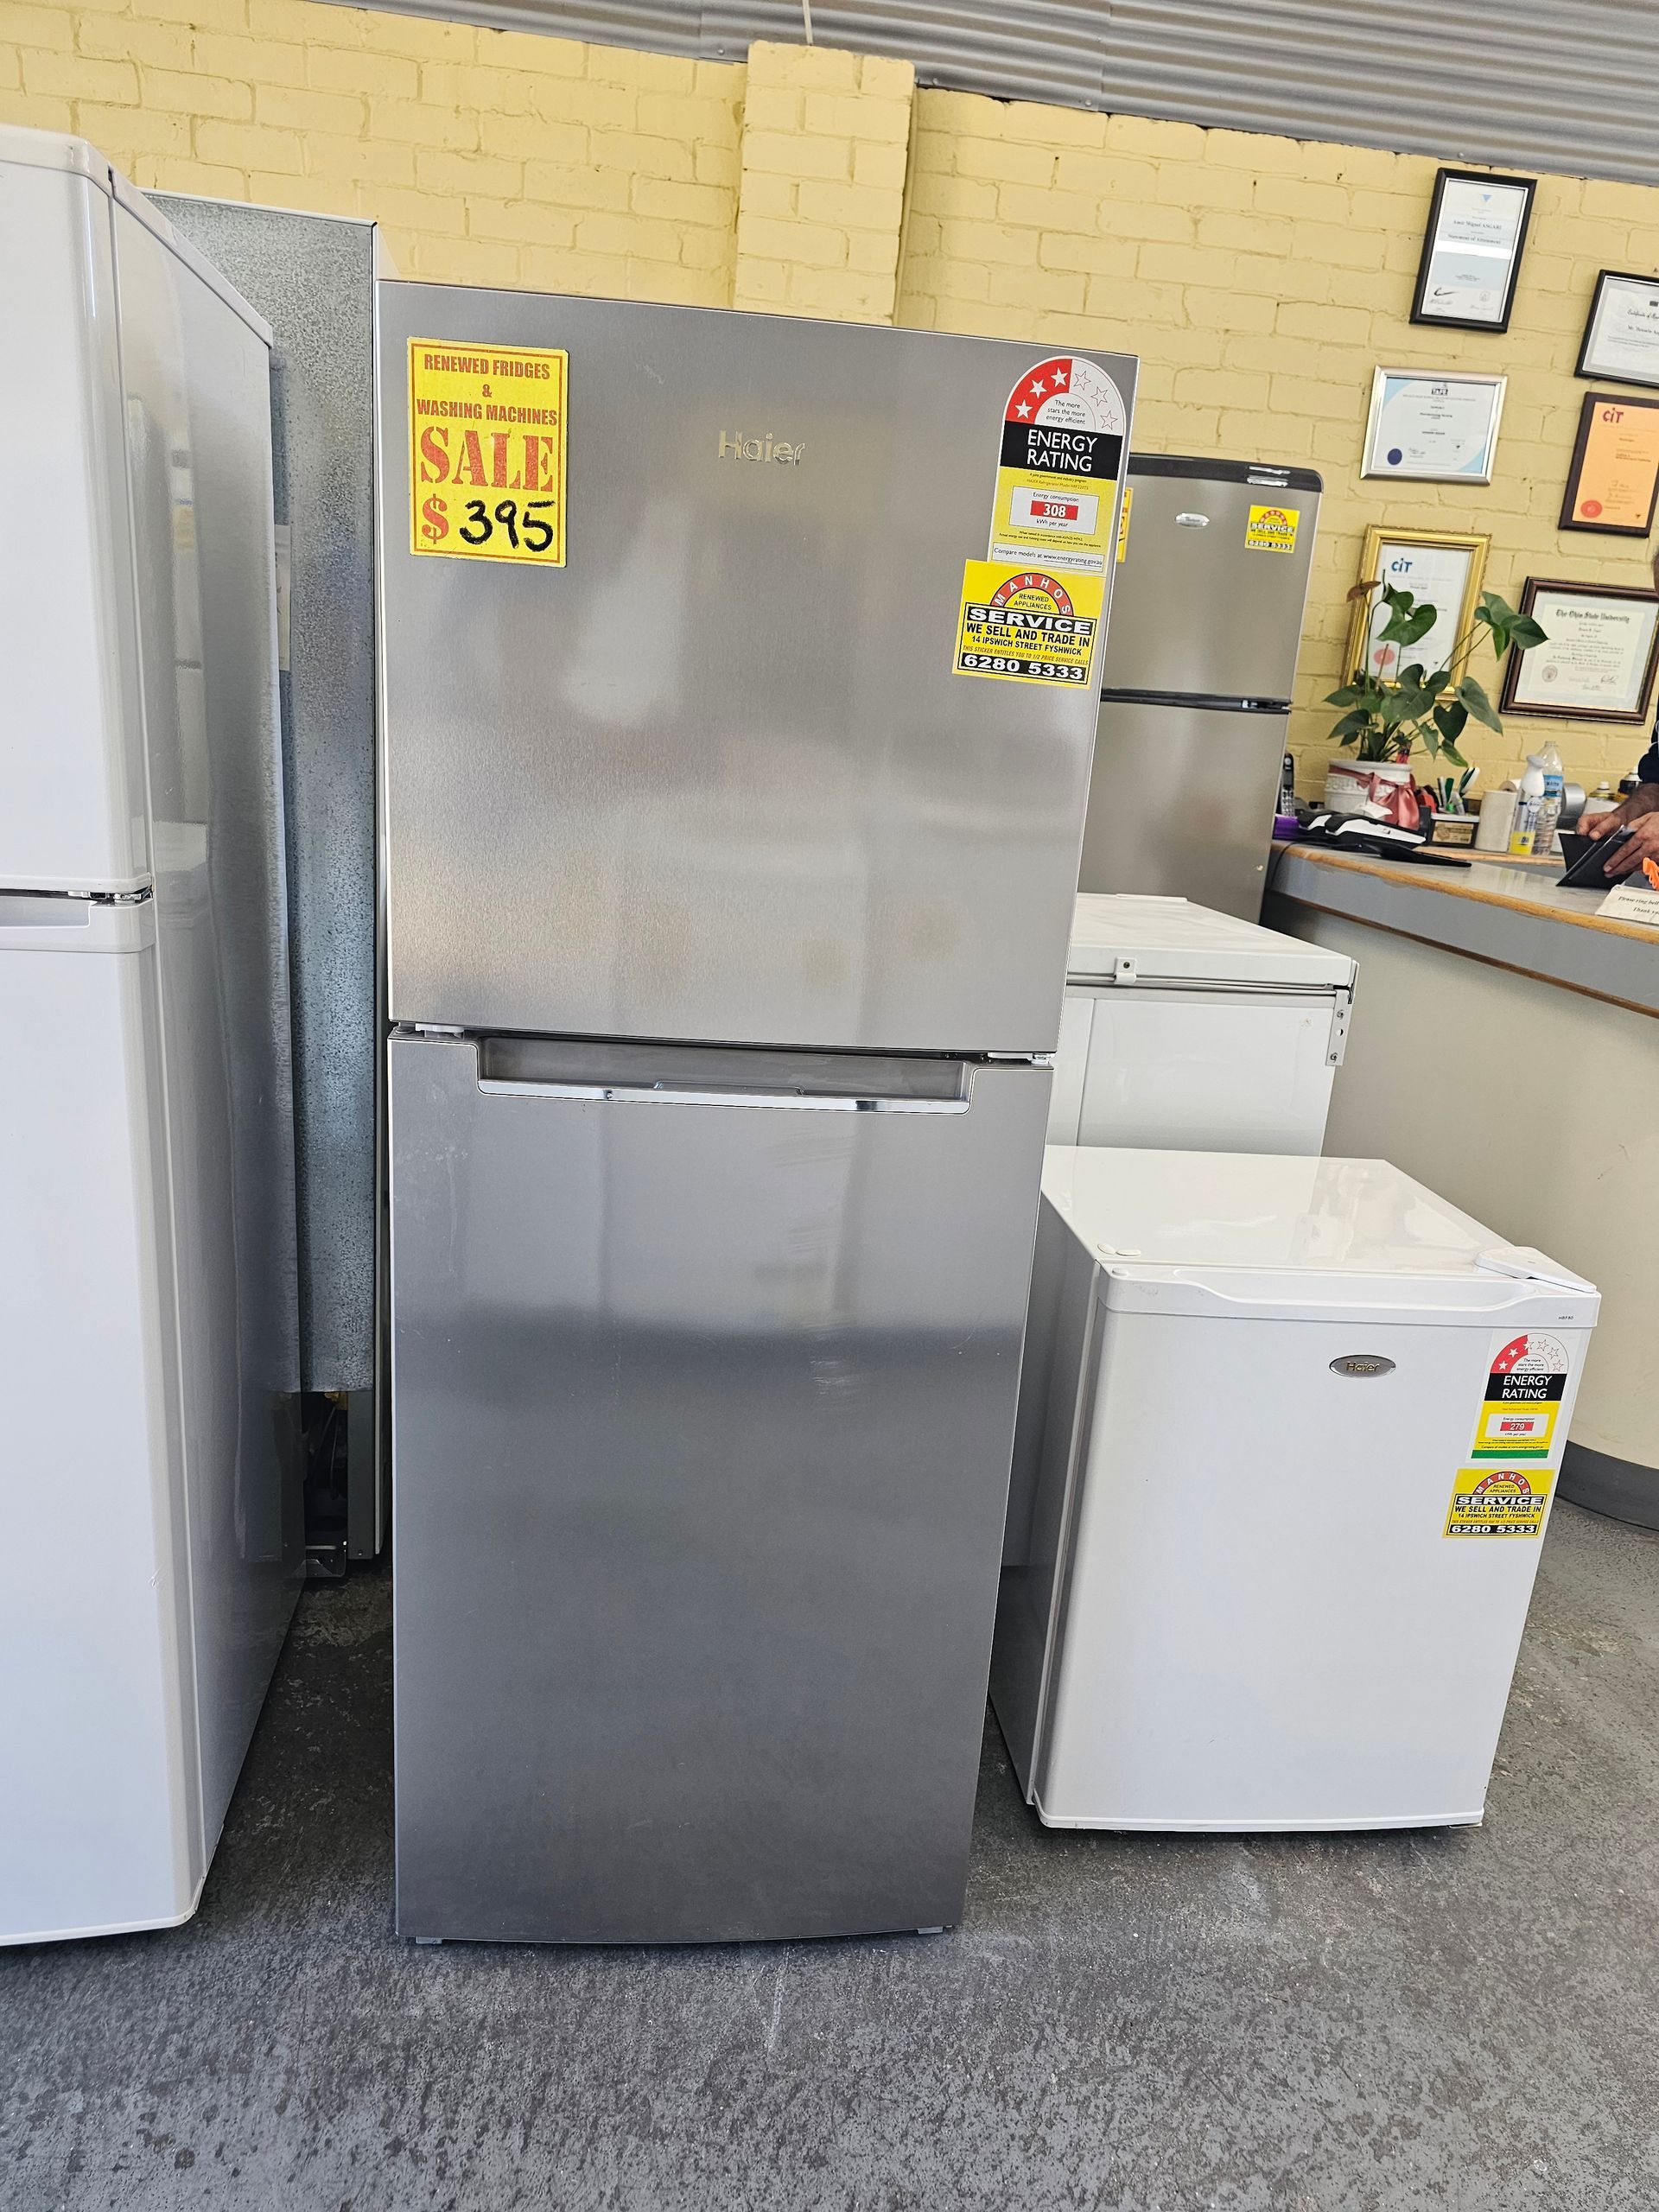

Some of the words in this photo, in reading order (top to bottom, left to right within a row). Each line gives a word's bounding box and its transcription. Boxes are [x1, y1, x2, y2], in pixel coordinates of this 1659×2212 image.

[424, 353, 489, 375] RENEWED
[493, 359, 550, 379] FRIDGES
[481, 385, 493, 397] &
[416, 398, 482, 420] WASHING
[486, 405, 557, 426] MACHINES
[718, 430, 805, 465] Haier
[1027, 429, 1098, 453] ENERGY
[421, 426, 553, 493] SALE
[1027, 448, 1092, 472] RATING
[1043, 504, 1065, 518] 308
[422, 493, 449, 544] $
[459, 499, 555, 552] 395
[994, 547, 1018, 556] Compare
[995, 575, 1071, 613] MANHOS
[1019, 593, 1049, 602] RENEWED
[1014, 601, 1052, 610] APPLIANCES
[969, 608, 1091, 635] SERVICE
[966, 623, 982, 634] WE
[986, 625, 1012, 638] SELL
[1015, 629, 1038, 641] AND
[1041, 632, 1076, 645] TRADE
[1079, 637, 1090, 647] IN
[982, 637, 1013, 647] IPSWICH
[1015, 640, 1043, 651] STREET
[1045, 645, 1082, 656] FYSHWICK
[963, 654, 1020, 671] 6280
[1028, 663, 1083, 679] 5333
[1346, 1362, 1379, 1372] Haier
[1503, 1376, 1553, 1386] ENERGY
[1502, 1389, 1548, 1399] RATING
[1476, 1472, 1529, 1494] MANHOS
[1457, 1497, 1543, 1505] SERVICE
[1452, 1525, 1491, 1534] 6280
[1496, 1525, 1535, 1534] 5333
